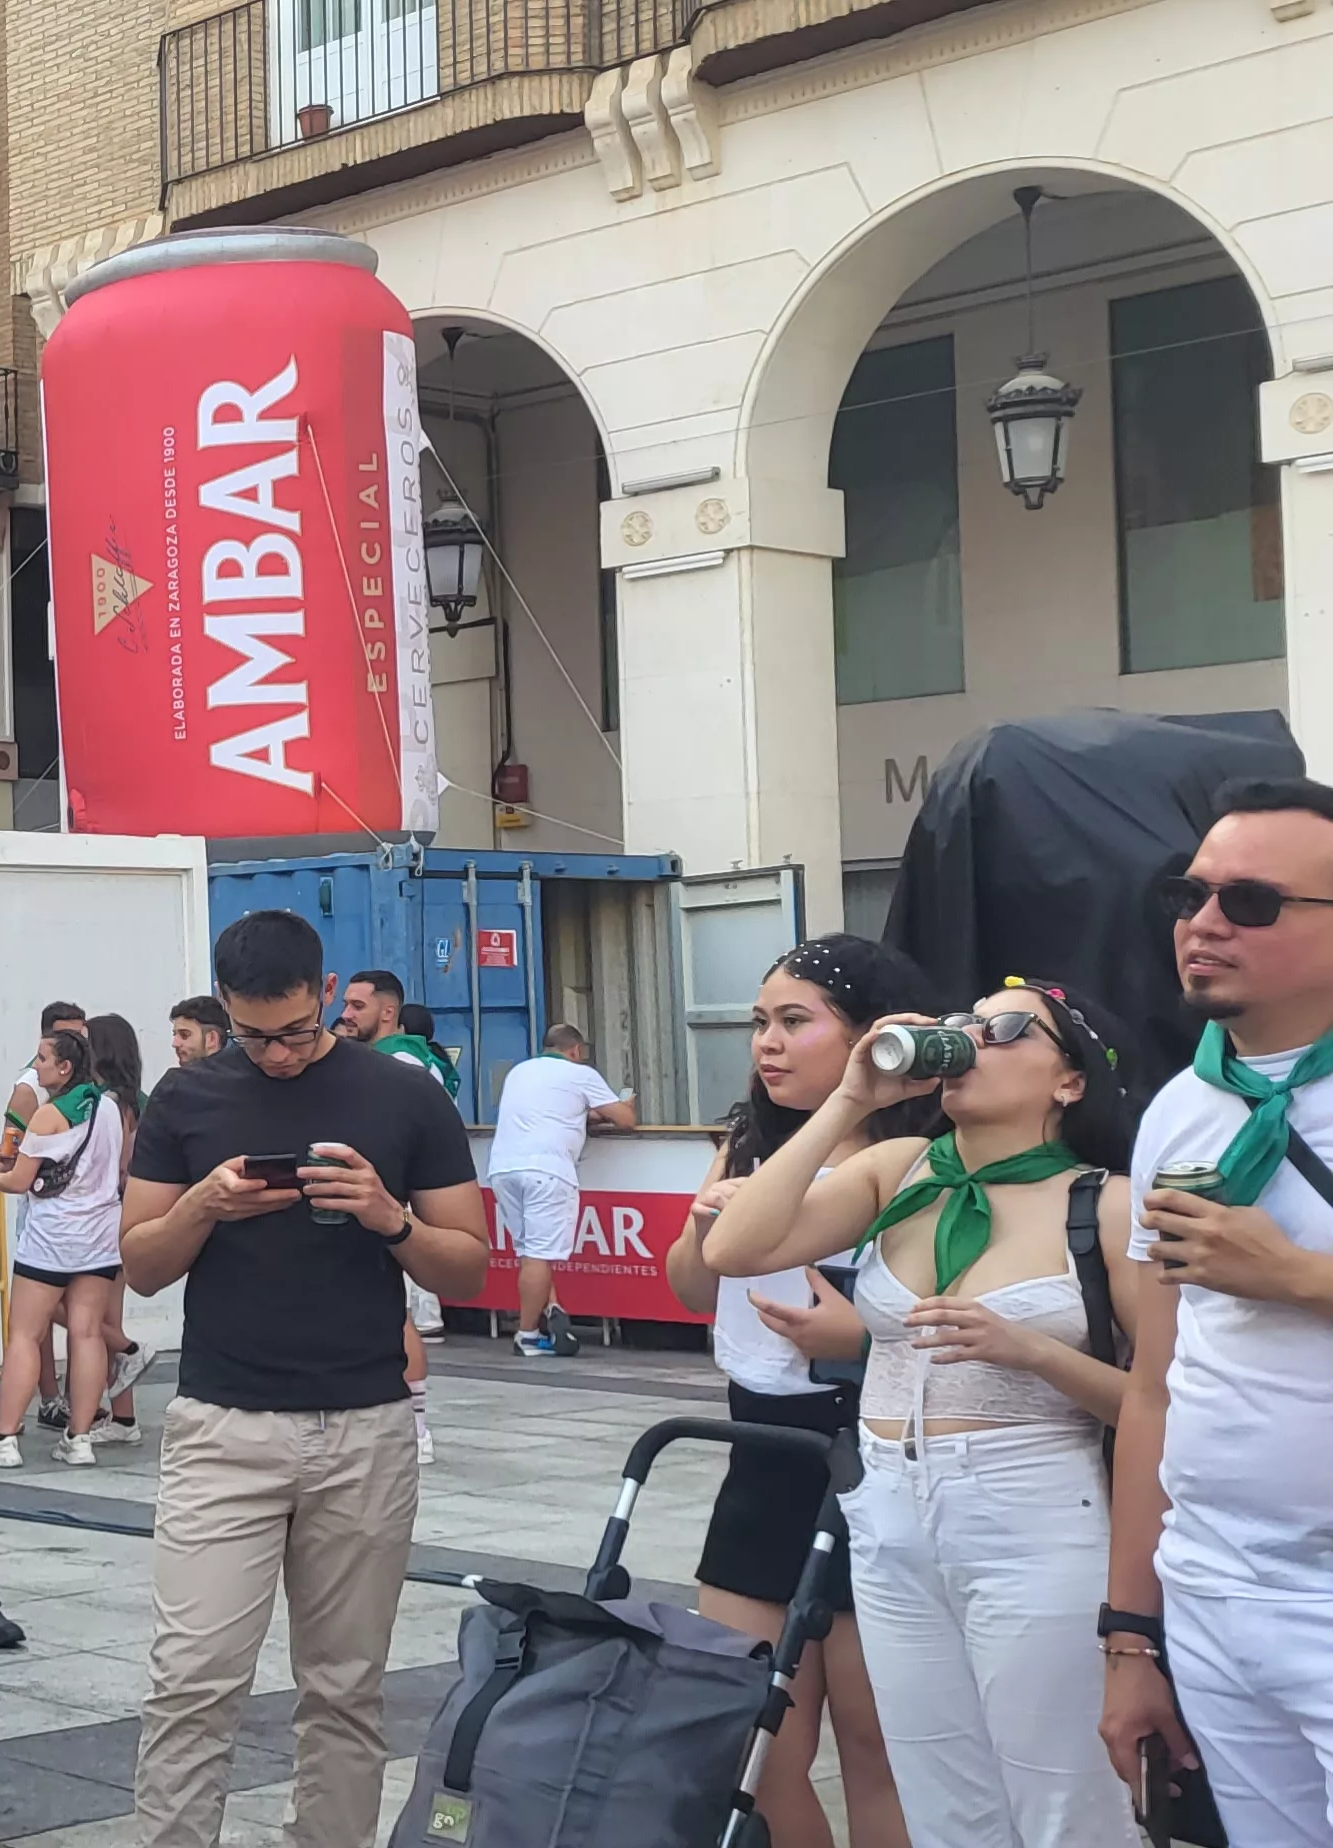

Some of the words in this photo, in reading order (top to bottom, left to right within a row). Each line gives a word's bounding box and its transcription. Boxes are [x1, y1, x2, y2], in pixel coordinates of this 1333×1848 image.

[162, 426, 176, 463] 1900
[164, 467, 178, 519] DESDE
[165, 523, 181, 612] ZARAGOZA
[197, 353, 315, 798] AMBAR
[358, 452, 388, 693] ESPECIAL
[397, 406, 429, 745] CERVECEROS
[169, 616, 182, 638] EN
[170, 643, 187, 740] ELABORADA
[551, 1262, 659, 1277] NDEPENDIENTES
